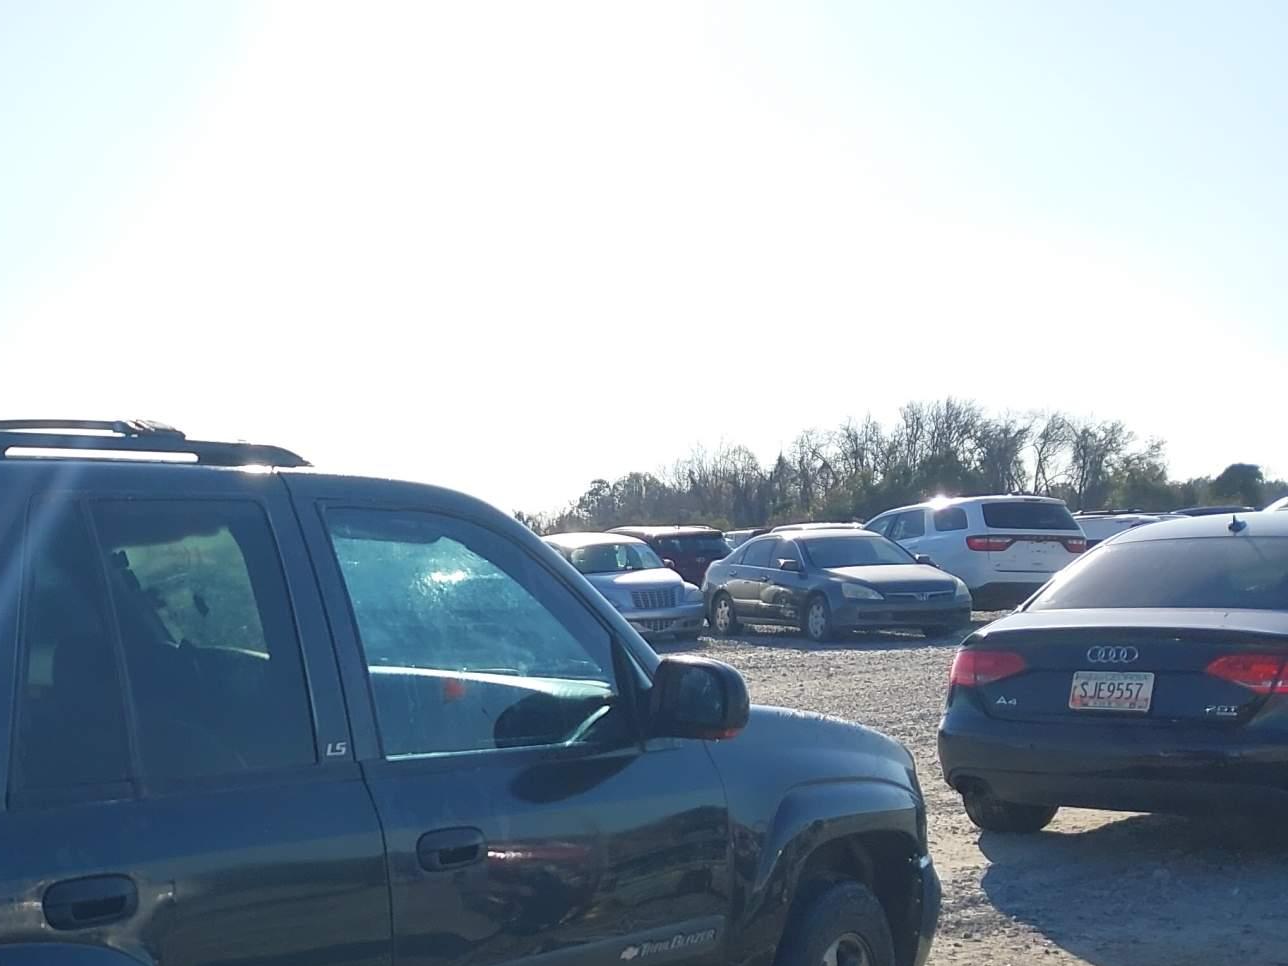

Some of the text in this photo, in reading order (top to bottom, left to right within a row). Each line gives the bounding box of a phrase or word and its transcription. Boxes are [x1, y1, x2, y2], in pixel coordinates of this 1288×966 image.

[1079, 681, 1144, 701] SJE9557
[995, 695, 1017, 706] A4
[326, 741, 347, 757] LS
